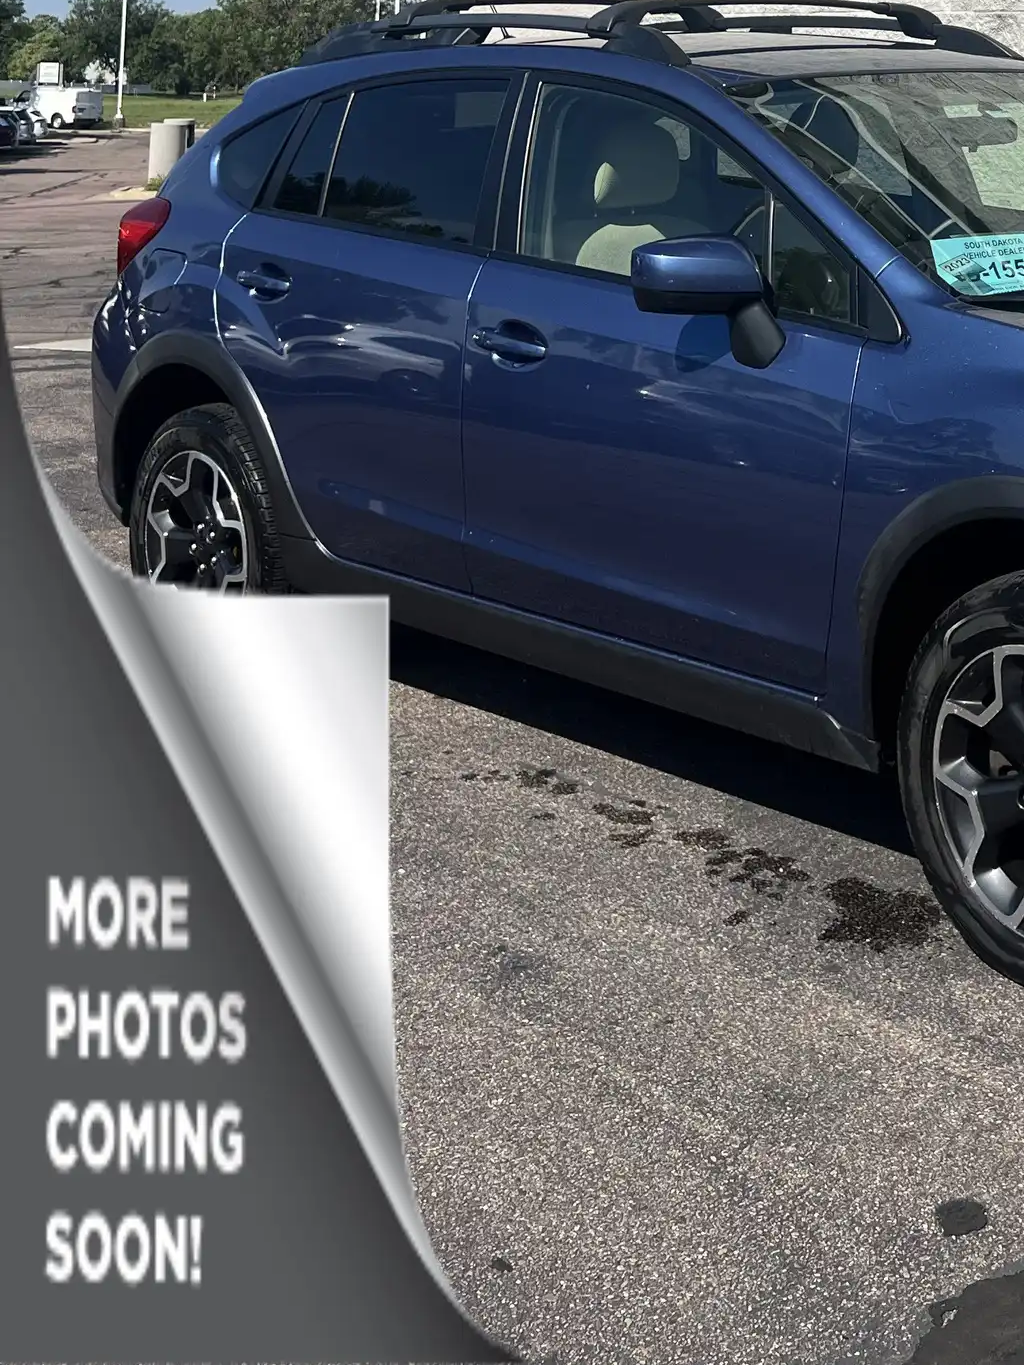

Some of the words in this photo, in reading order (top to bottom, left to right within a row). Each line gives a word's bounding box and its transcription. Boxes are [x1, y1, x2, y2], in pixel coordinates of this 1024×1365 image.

[964, 240, 991, 250] SOUTH
[992, 237, 1024, 247] DAKOTA
[964, 249, 997, 260] VEHICLE
[944, 257, 971, 272] 2023
